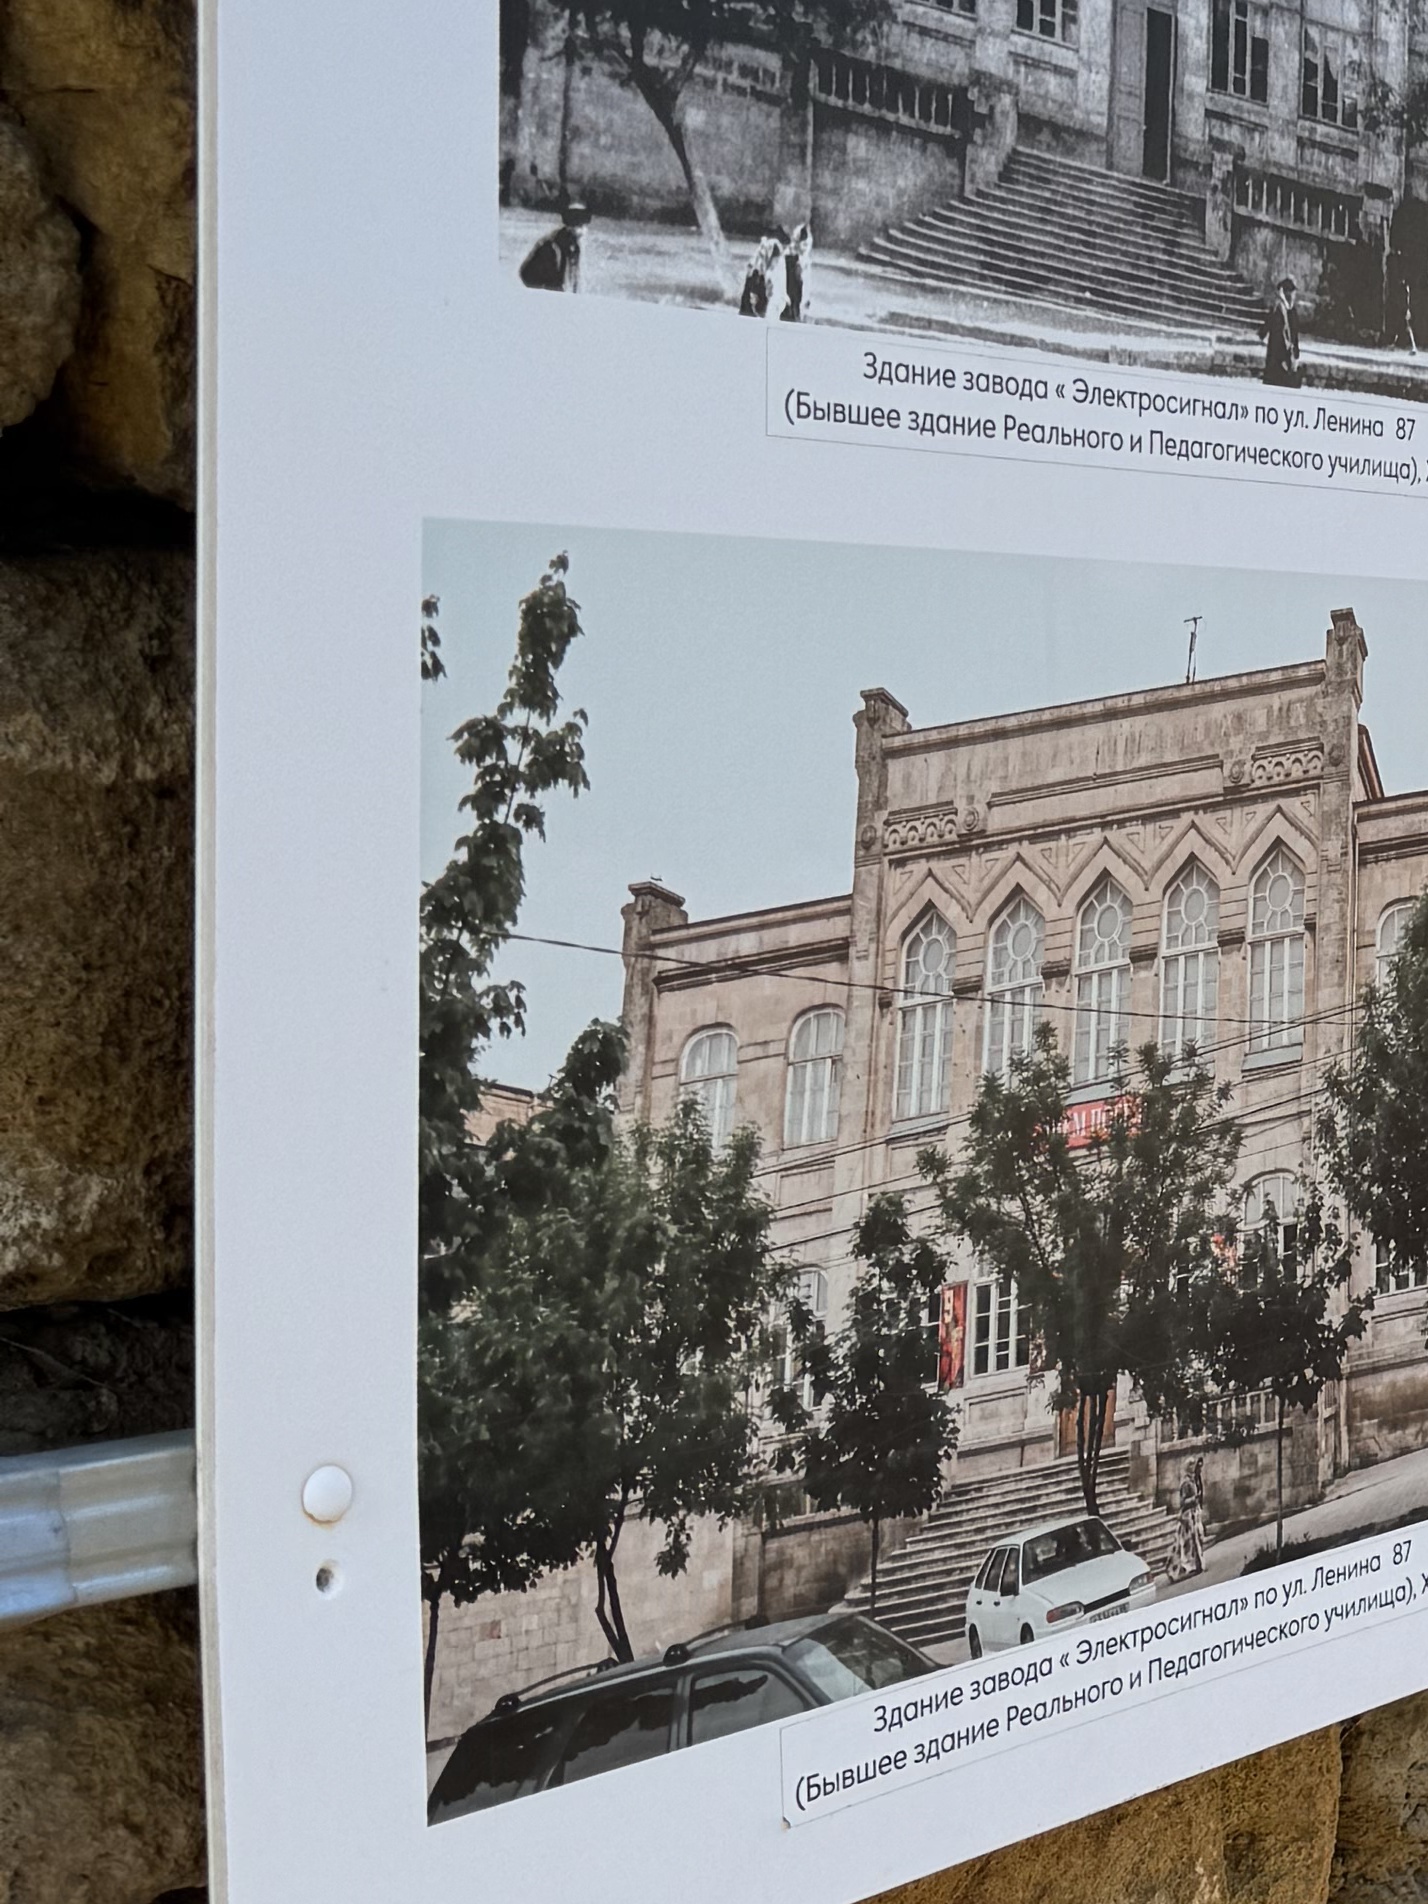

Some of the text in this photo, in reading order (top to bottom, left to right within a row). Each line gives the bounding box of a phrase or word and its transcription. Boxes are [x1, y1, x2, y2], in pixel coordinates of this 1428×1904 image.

[784, 387, 902, 430] (Бывшее
[907, 410, 997, 439] здание
[1003, 413, 1124, 452] Реального
[1129, 433, 1143, 454] и
[1149, 429, 1324, 471] Педагогического
[1327, 453, 1422, 487] училища),
[862, 351, 957, 389] Здание
[962, 370, 1049, 403] завода
[1072, 377, 1250, 422] Электросигнал»
[1254, 405, 1279, 426] по
[1282, 407, 1310, 434] ул.
[1312, 406, 1384, 438] Ленина
[1395, 416, 1416, 442] 87
[795, 1749, 908, 1811] (Бывшее
[913, 1717, 1000, 1765] здание
[1006, 1676, 1124, 1733] Реального
[1129, 1669, 1142, 1691] и
[1148, 1612, 1320, 1685] Педагогического
[1323, 1575, 1417, 1633] училища),
[873, 1686, 964, 1734] Здание
[969, 1656, 1053, 1701] завода
[1075, 1596, 1249, 1665] Электросигнал»
[1254, 1586, 1278, 1610] по
[1281, 1577, 1308, 1609] ул.
[1310, 1554, 1382, 1593] Ленина
[1392, 1539, 1413, 1566] 87
